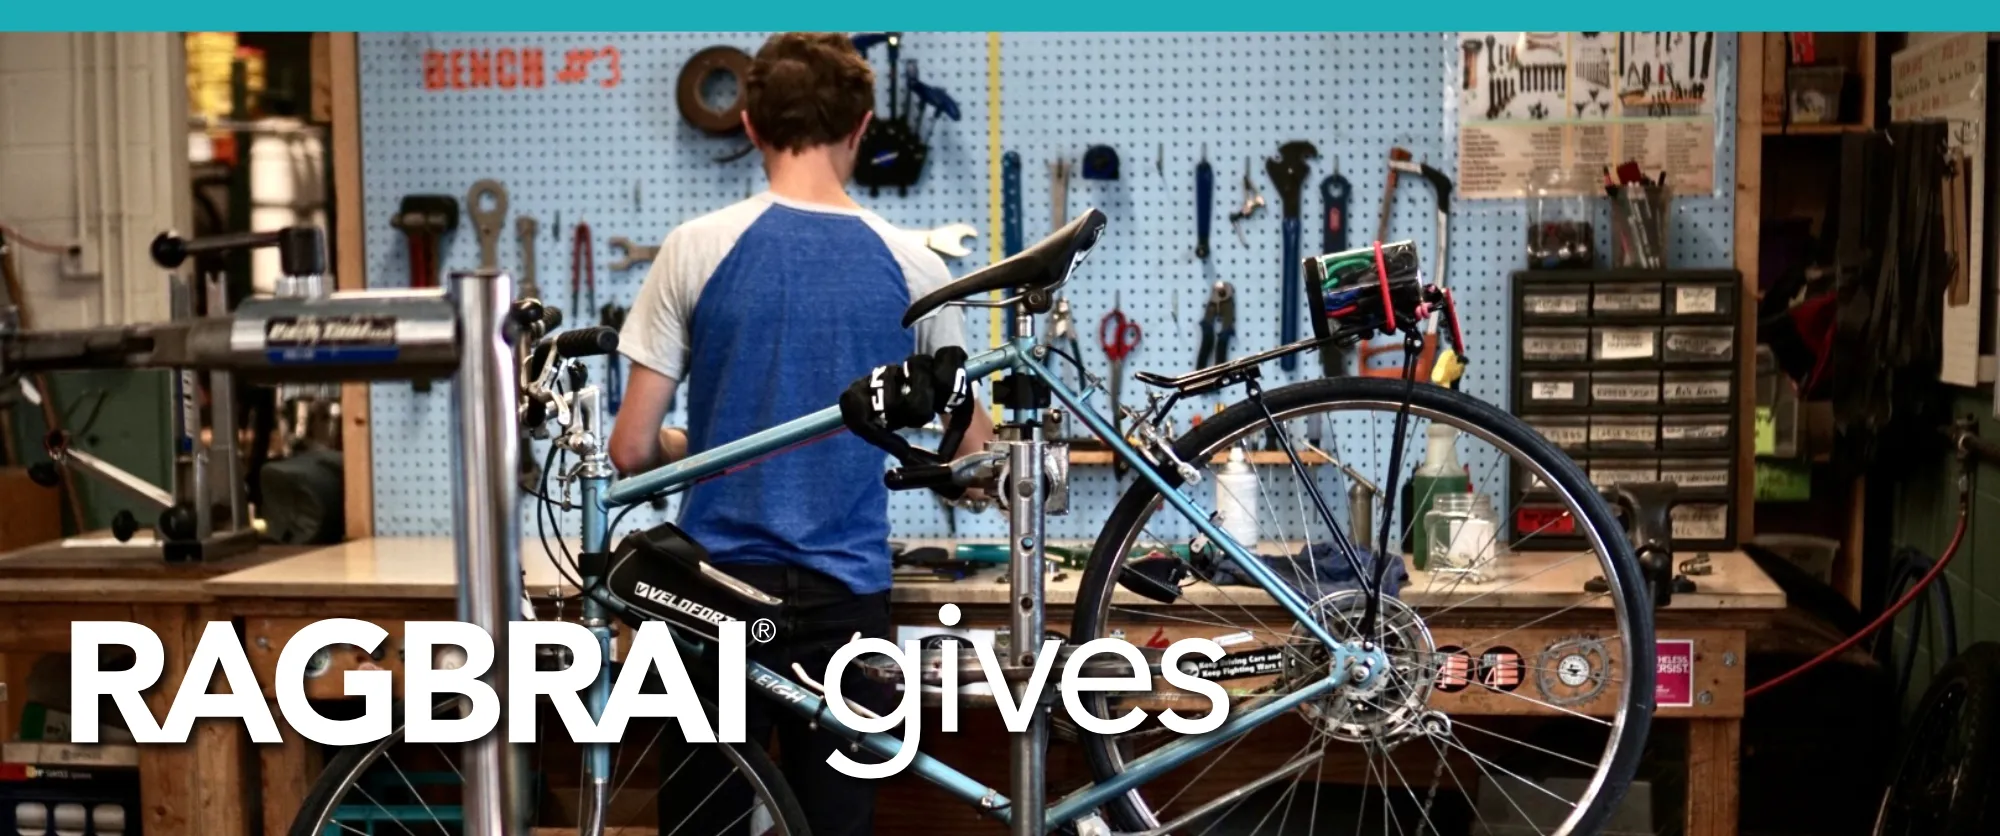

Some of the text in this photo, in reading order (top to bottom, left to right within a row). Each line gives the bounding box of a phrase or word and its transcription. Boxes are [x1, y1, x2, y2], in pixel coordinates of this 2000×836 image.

[423, 47, 545, 91] BENCH
[1248, 655, 1266, 664] Cars
[1267, 652, 1282, 661] and
[1201, 669, 1222, 678] Keep
[1223, 666, 1255, 676] Fighting
[1256, 661, 1274, 671] Wars
